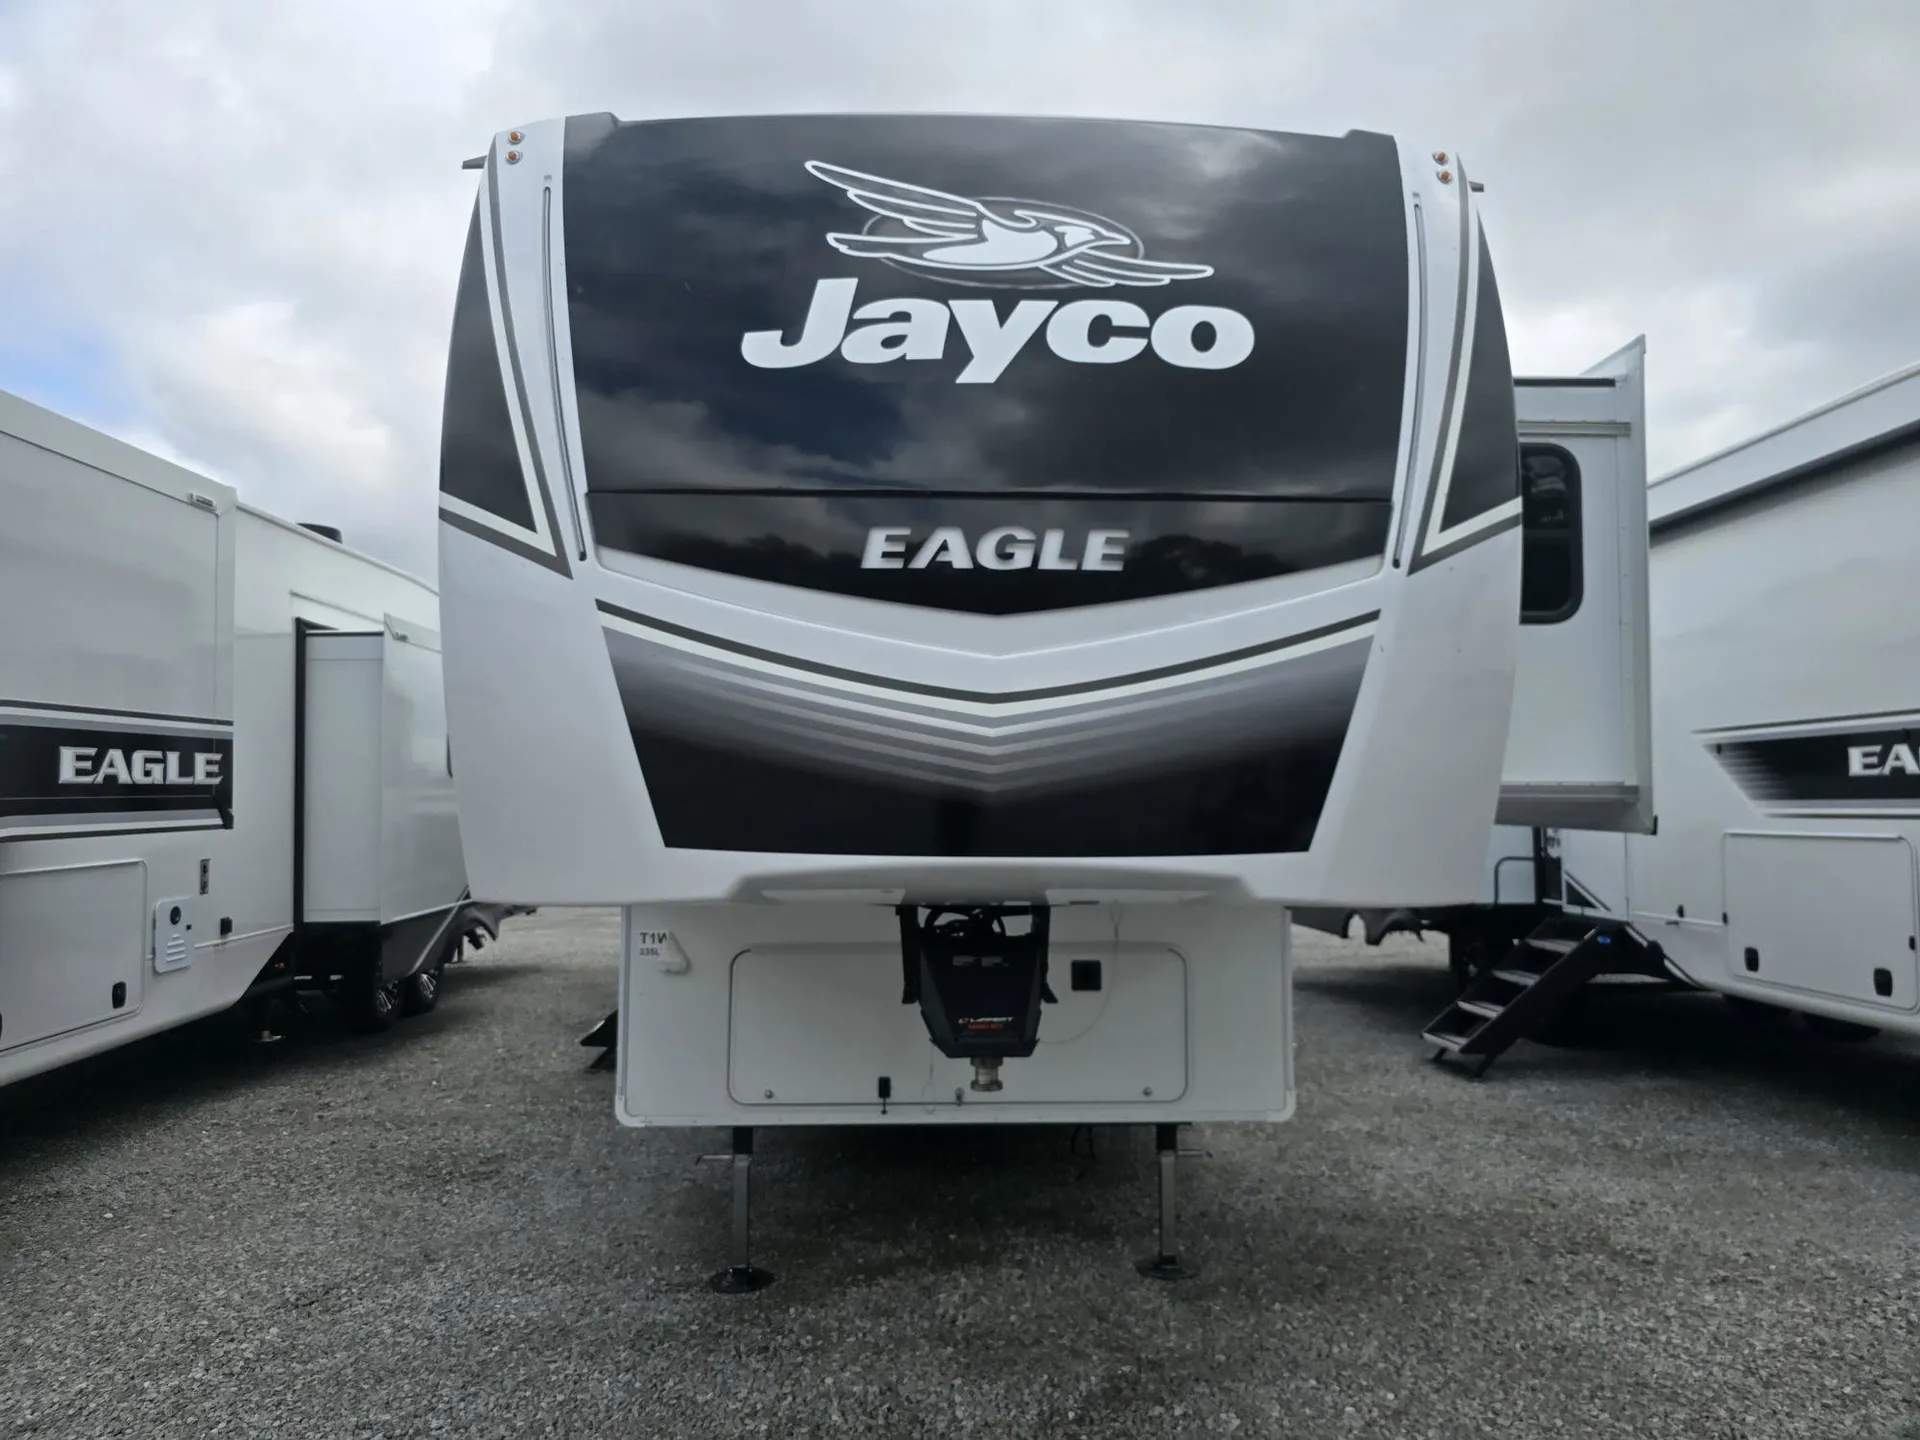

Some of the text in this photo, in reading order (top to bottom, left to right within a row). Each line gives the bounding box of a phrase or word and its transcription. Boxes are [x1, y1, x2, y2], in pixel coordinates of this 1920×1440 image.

[741, 277, 1255, 384] Jayco
[860, 526, 1130, 571] EAGLE
[58, 746, 223, 785] EAGLE
[1847, 743, 1920, 777] EA
